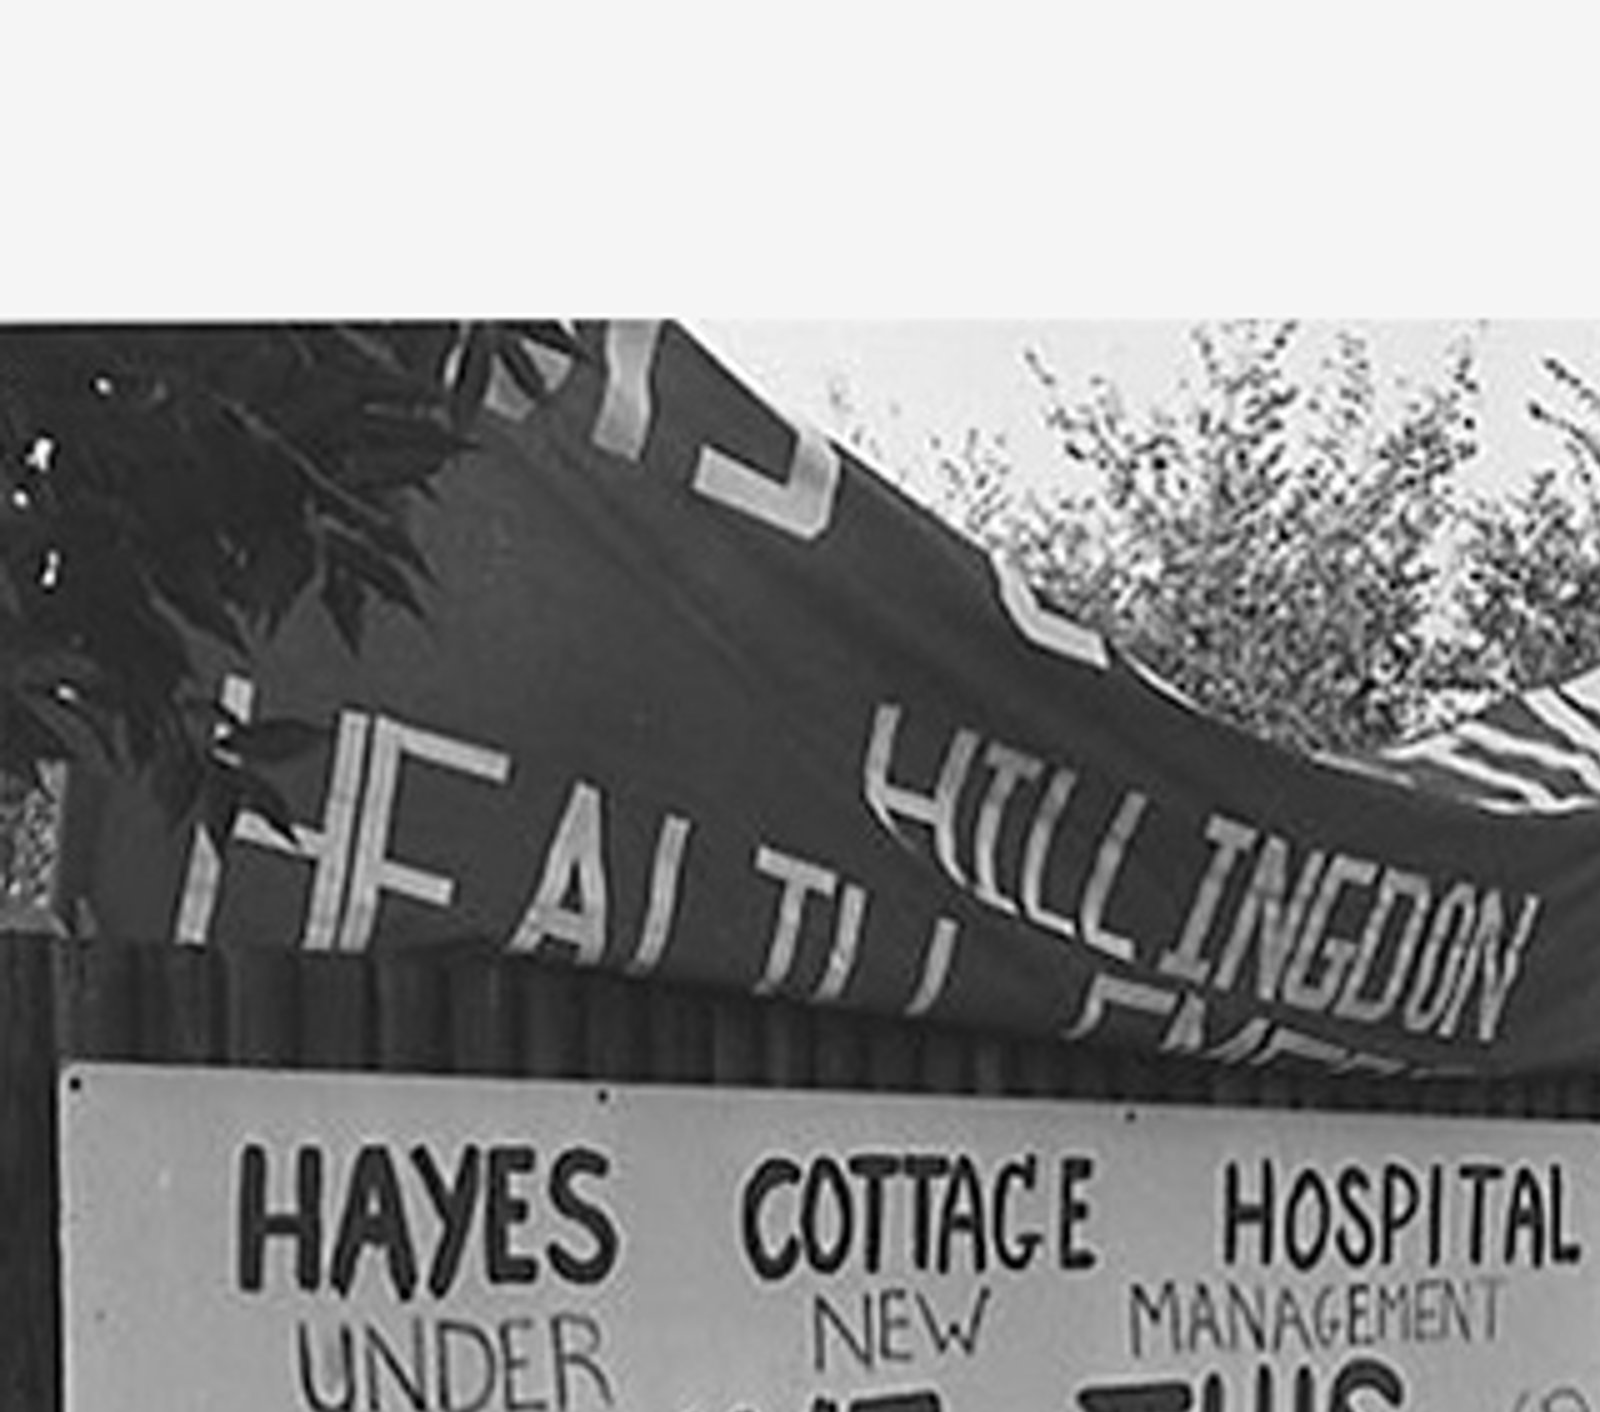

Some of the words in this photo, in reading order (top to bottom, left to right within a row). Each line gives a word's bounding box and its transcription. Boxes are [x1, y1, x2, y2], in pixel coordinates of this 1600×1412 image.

[863, 703, 1539, 1043] HILLINGDON
[237, 1143, 620, 1302] HAYES
[742, 1153, 1097, 1282] COTTAGE
[1223, 1158, 1583, 1270] HOSPITAL
[812, 1286, 992, 1376] NEW
[1128, 1278, 1508, 1358] MANAGEMENT
